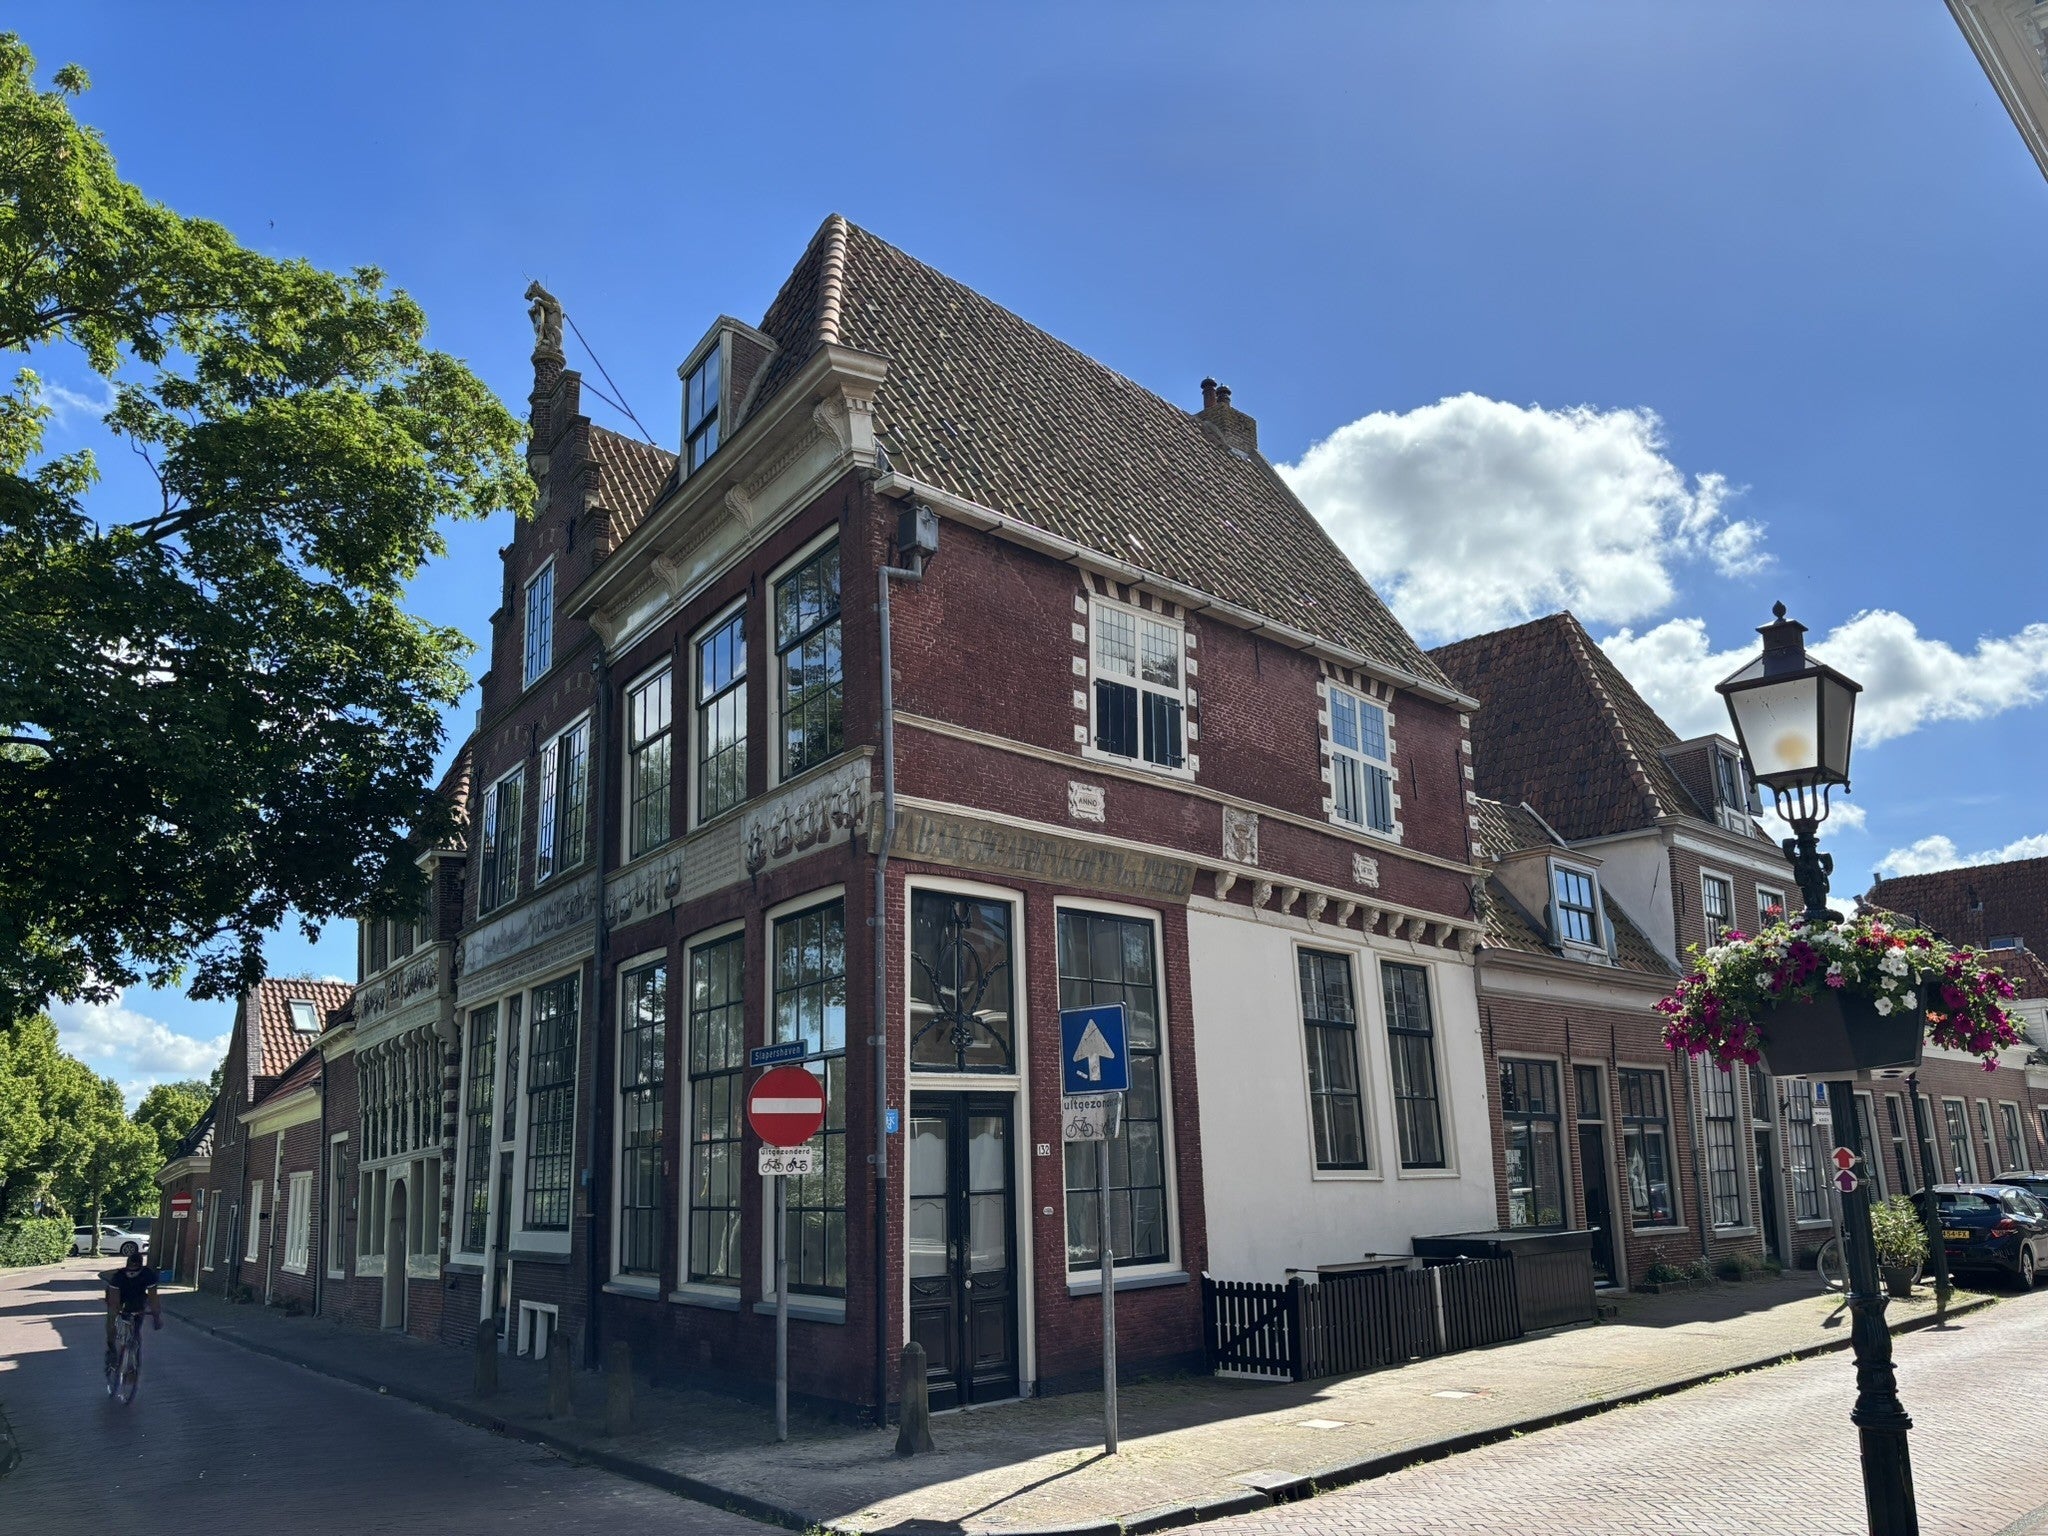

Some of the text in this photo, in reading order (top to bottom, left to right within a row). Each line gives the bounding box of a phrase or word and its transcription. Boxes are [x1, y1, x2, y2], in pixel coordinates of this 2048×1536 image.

[1078, 797, 1098, 807] ANNO
[755, 1046, 800, 1061] Slapershaven
[1037, 1146, 1050, 1156] 132
